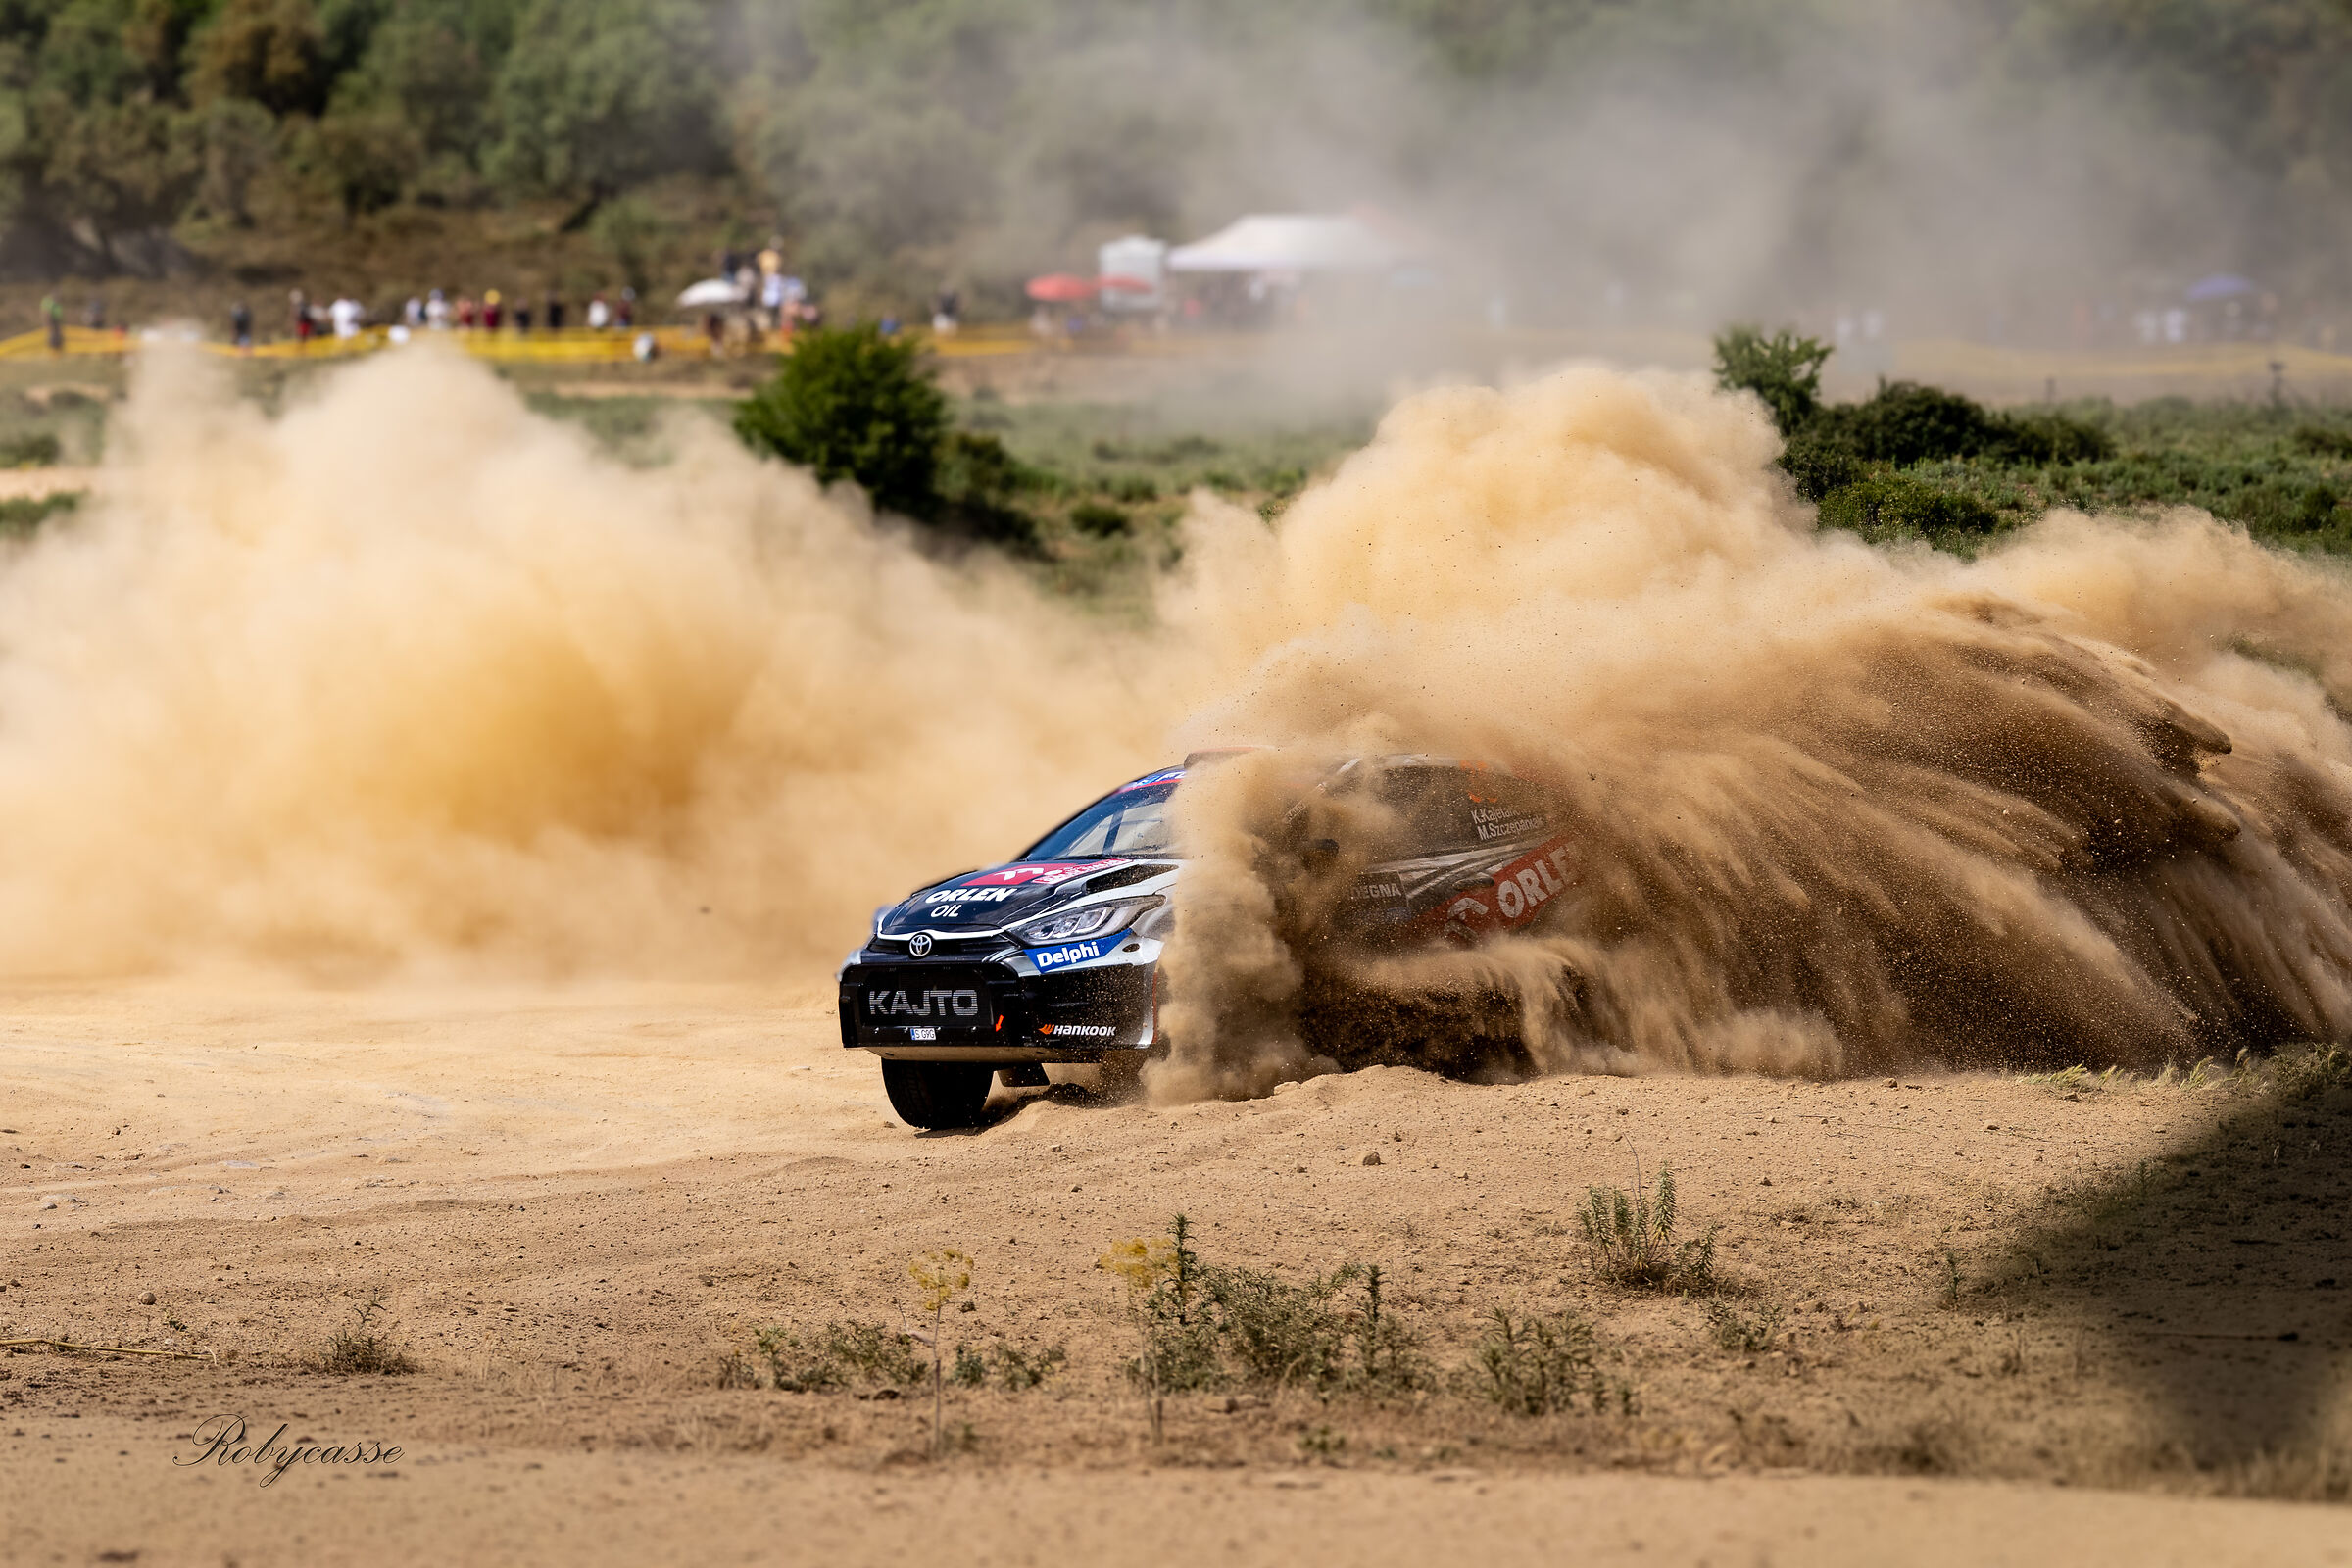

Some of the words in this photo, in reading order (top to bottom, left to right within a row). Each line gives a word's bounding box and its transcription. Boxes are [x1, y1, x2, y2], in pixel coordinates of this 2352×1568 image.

[1497, 841, 1574, 919] ORLE
[925, 887, 1018, 904] ORLEN
[930, 904, 962, 918] OIL
[1036, 941, 1101, 968] Delphi
[868, 989, 979, 1016] KAJTO
